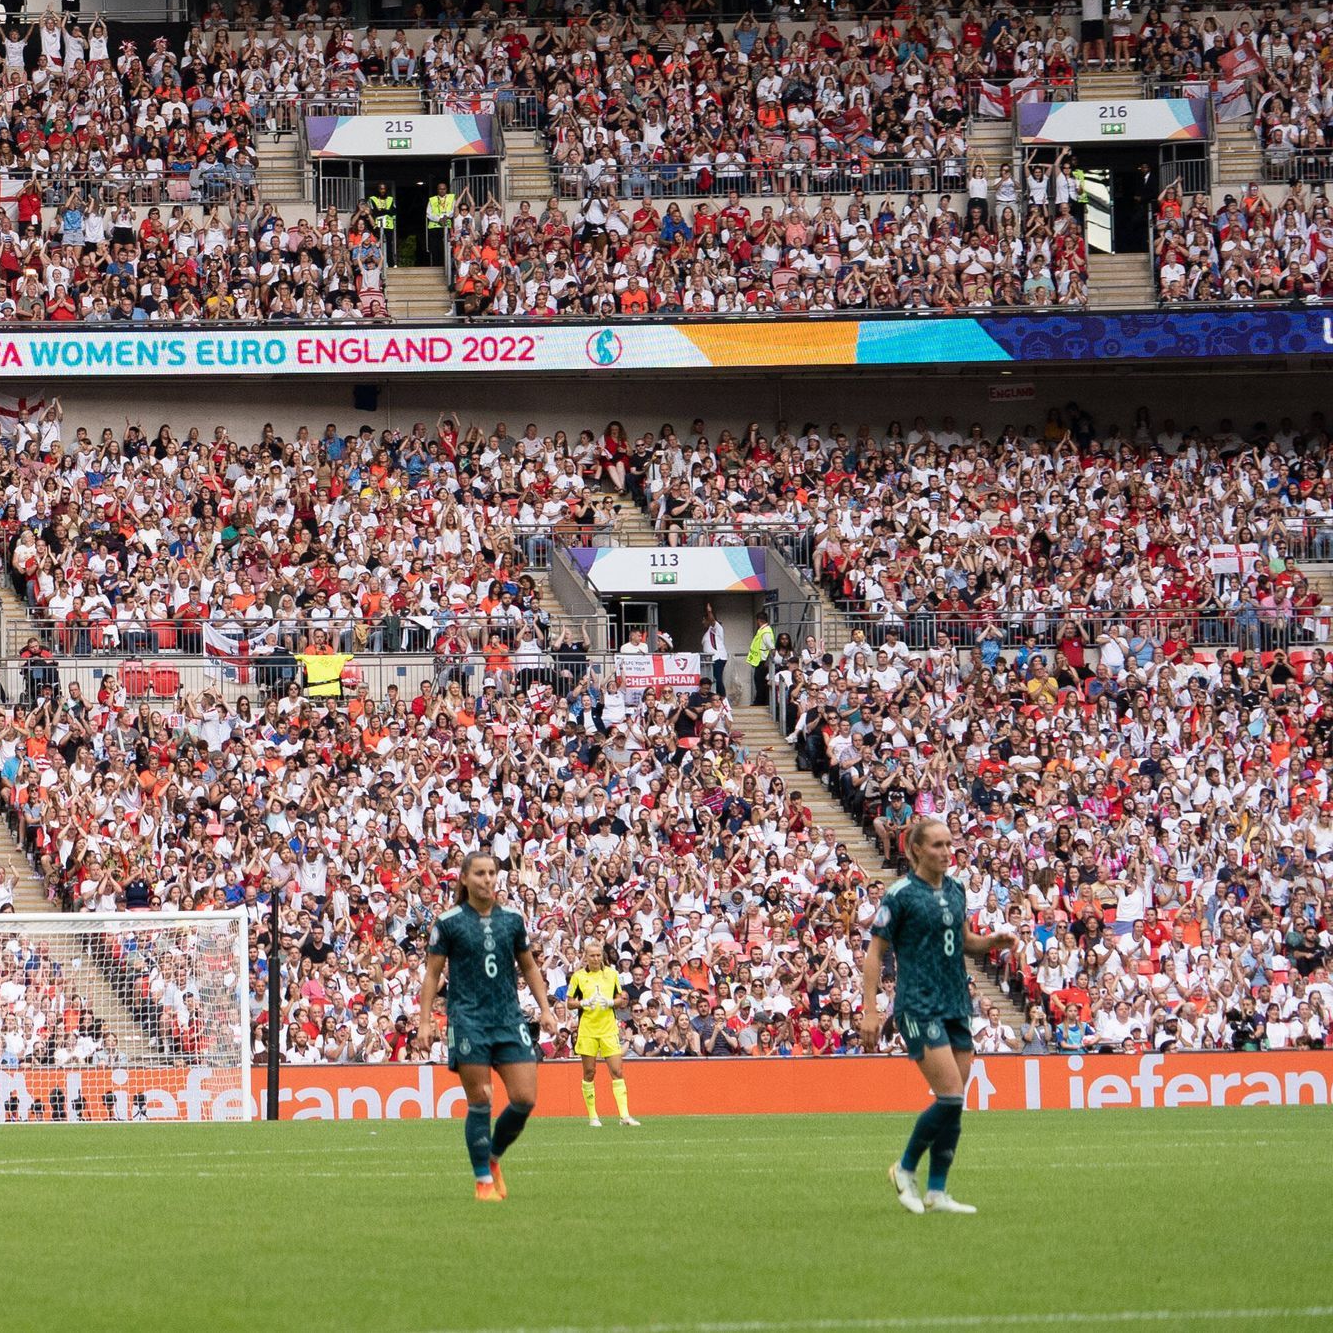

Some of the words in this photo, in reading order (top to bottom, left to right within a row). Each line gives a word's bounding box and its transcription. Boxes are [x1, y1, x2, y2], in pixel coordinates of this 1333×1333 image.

[1099, 106, 1128, 118] 216
[385, 121, 413, 133] 215
[30, 340, 186, 367] WOMEN'S
[197, 339, 286, 366] EURO
[298, 338, 452, 364] ENGLAND
[989, 386, 1035, 399] ENGLAND
[650, 554, 679, 567] 113
[625, 675, 695, 686] CHELTENHAM
[944, 928, 955, 956] 8
[485, 953, 498, 978] 6
[519, 1023, 532, 1047] 6
[1024, 1054, 1333, 1109] Lieferan
